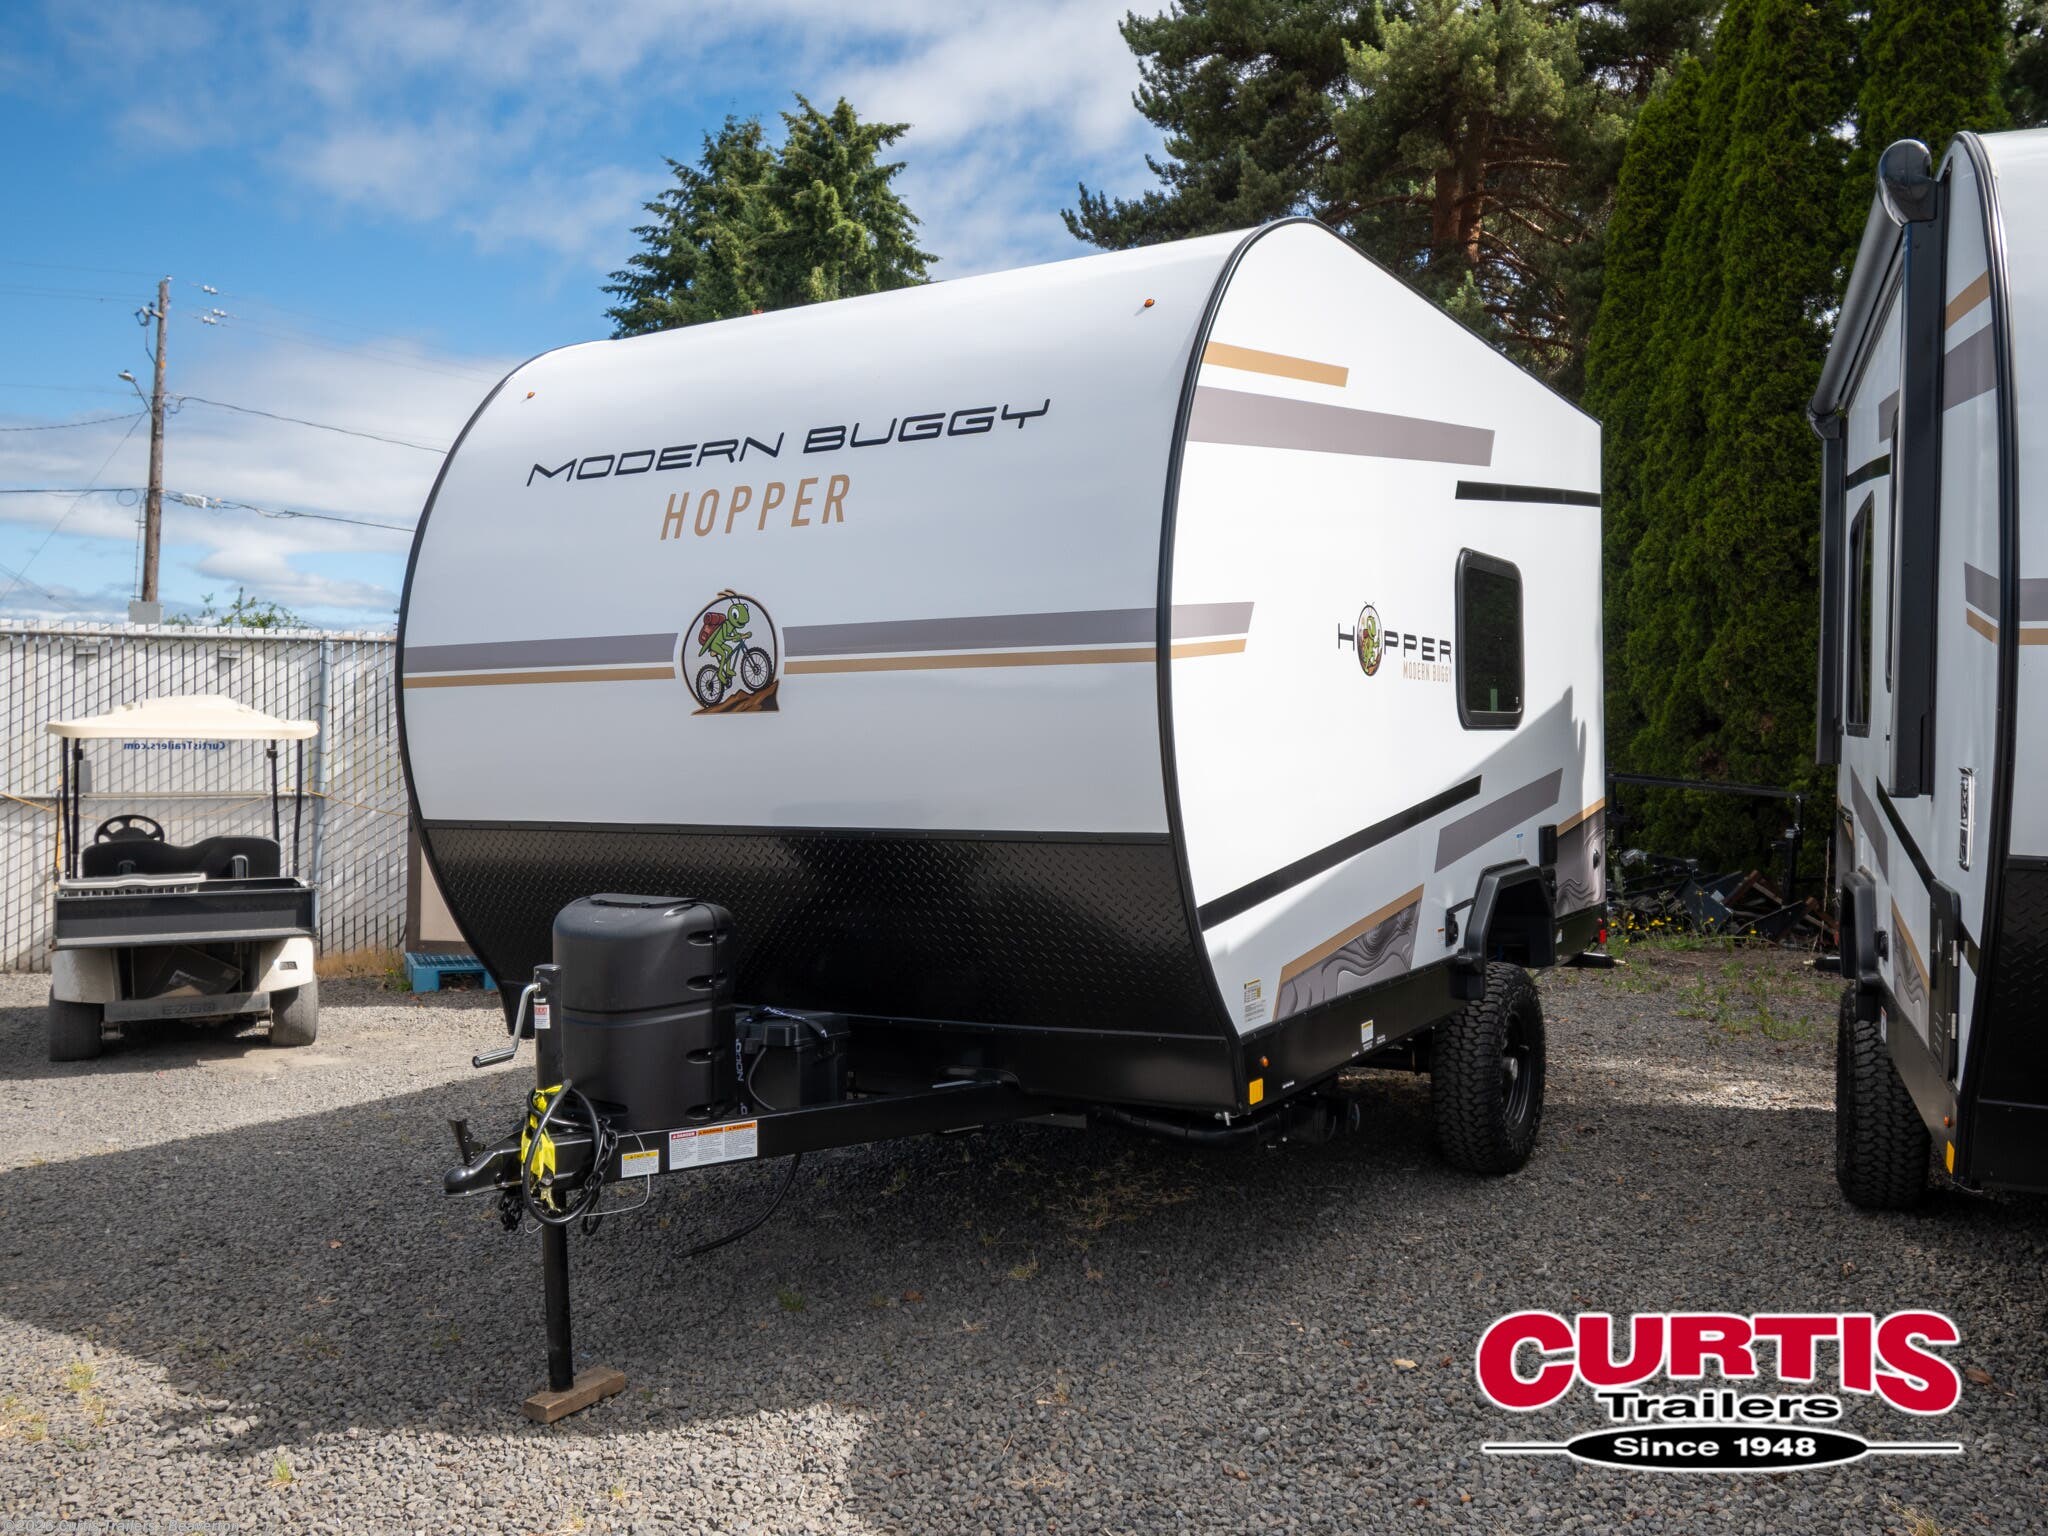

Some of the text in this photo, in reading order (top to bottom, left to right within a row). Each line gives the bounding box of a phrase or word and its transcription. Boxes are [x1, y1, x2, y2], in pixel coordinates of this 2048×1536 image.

[527, 398, 1051, 487] MODERN BUGGY
[660, 474, 851, 541] HOPPER
[1403, 661, 1452, 683] MODERN BUGGY
[764, 1006, 807, 1021] NO
